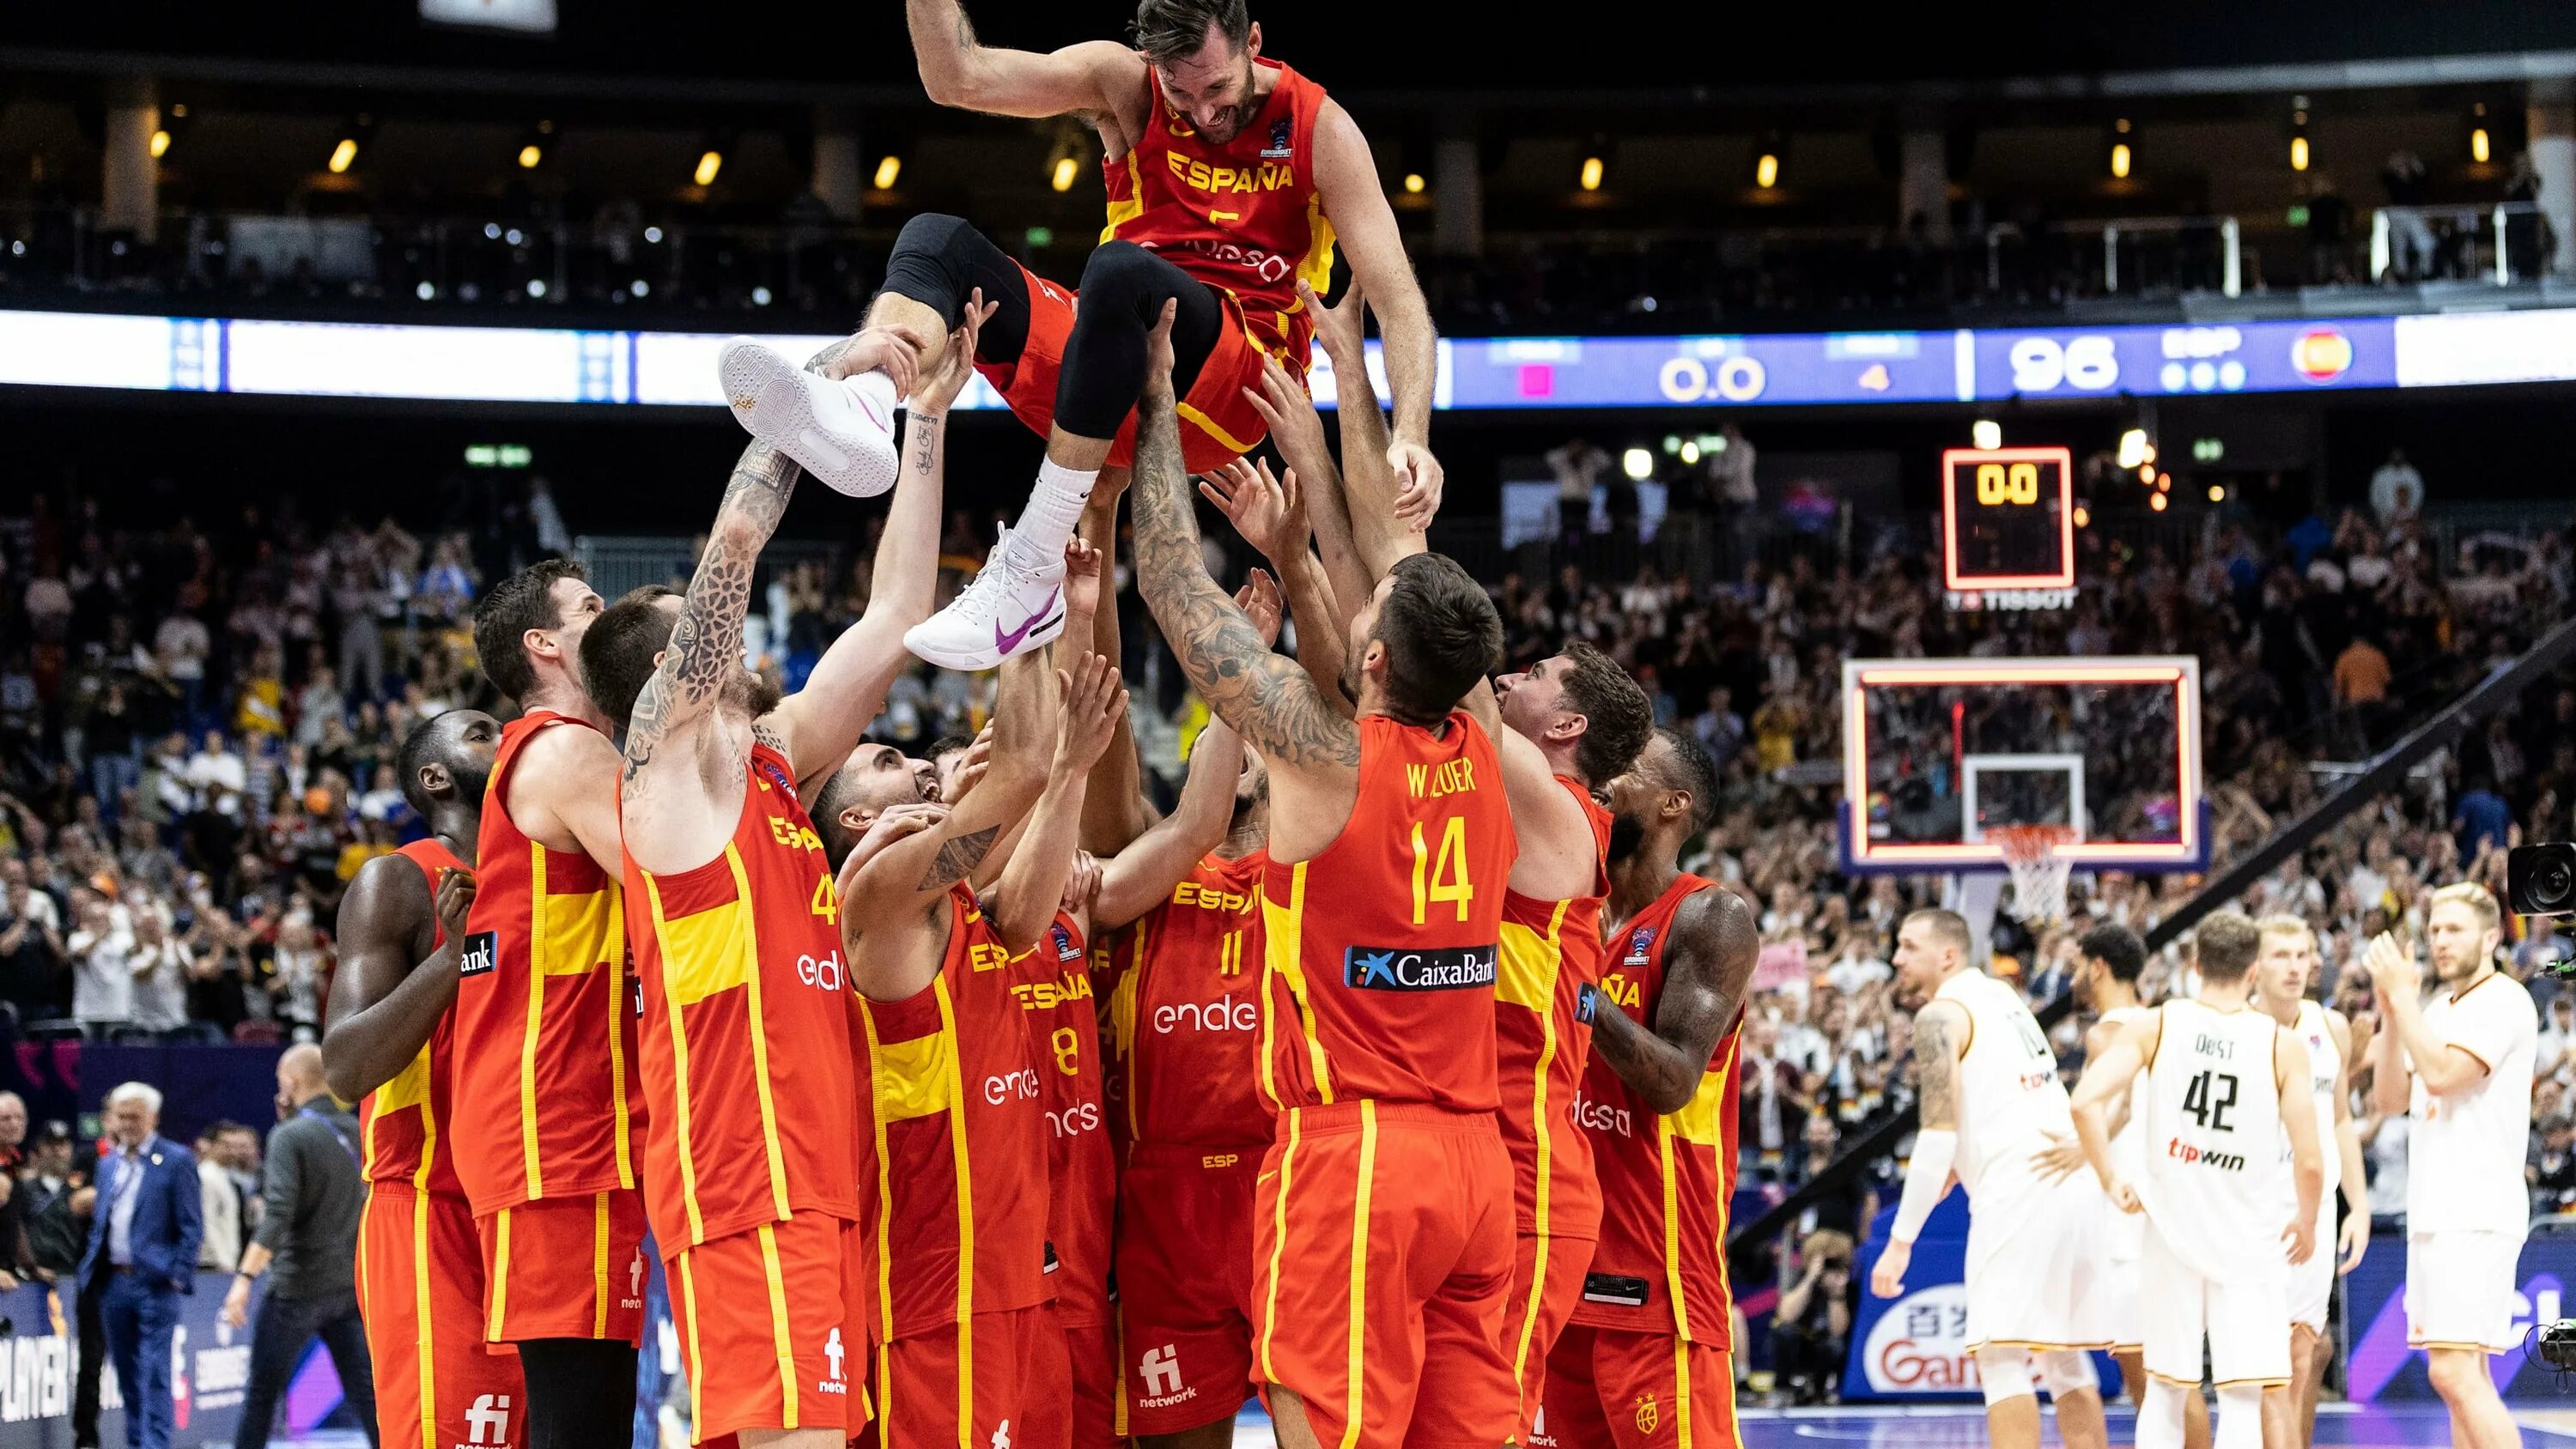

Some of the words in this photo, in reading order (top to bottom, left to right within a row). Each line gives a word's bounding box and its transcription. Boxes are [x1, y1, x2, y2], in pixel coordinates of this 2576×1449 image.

[1167, 149, 1293, 194] ESPAÑA
[2009, 336, 2118, 391] 96
[1411, 816, 1473, 925] 14
[811, 872, 837, 925] 4
[1221, 929, 1242, 975] 11
[1396, 953, 1494, 986] CaixaBank
[1051, 1027, 1078, 1076] 8
[2183, 1070, 2239, 1133] 42
[1202, 1154, 1238, 1168] ESP
[2168, 1137, 2245, 1172] tipwin
[465, 1393, 511, 1444] fi
[1139, 1386, 1198, 1410] network
[1527, 1434, 1558, 1448] work
